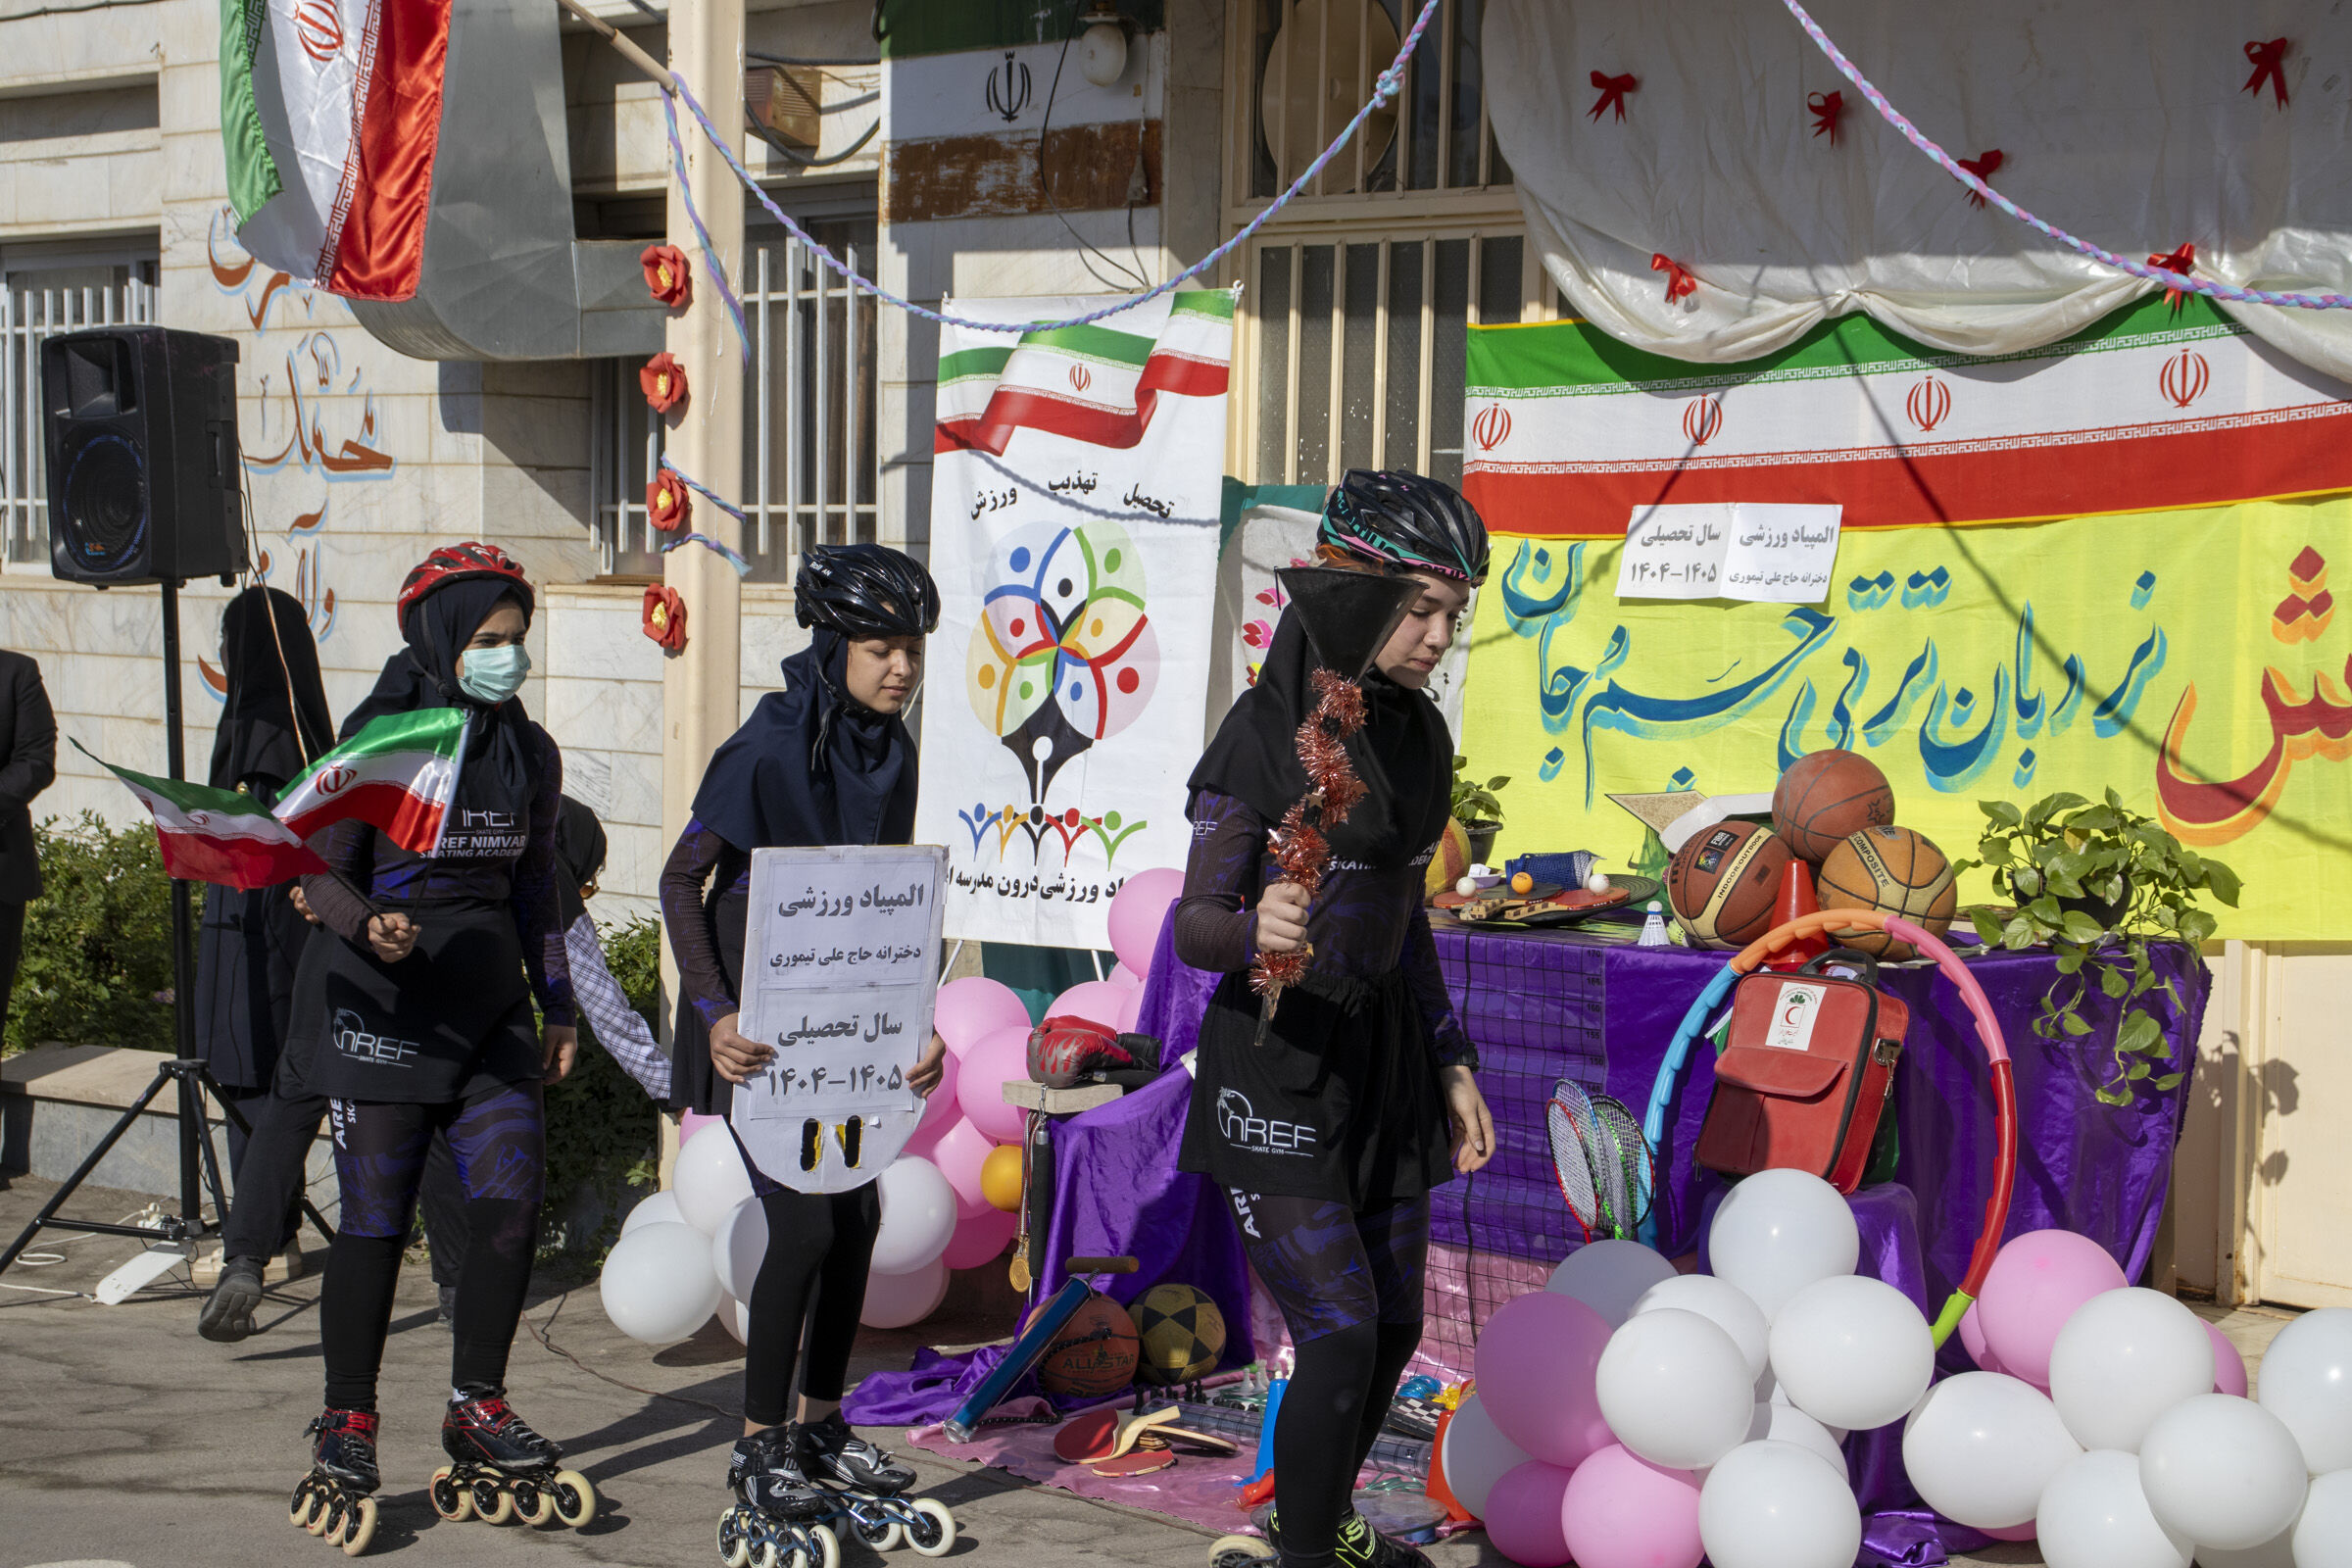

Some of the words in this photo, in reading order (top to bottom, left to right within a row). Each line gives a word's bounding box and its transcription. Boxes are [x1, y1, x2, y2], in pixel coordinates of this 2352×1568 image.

[1048, 469, 1099, 497] تهذیب
[970, 486, 1017, 520] ورزش
[1123, 482, 1175, 519] تحصیل
[1641, 524, 1694, 548] تحصیلی
[1695, 523, 1721, 547] سال
[1740, 523, 1788, 549] ورزشی
[1791, 524, 1835, 550] المپیاد
[1729, 570, 1764, 583] تیموری
[1765, 571, 1782, 585] علی
[1783, 573, 1798, 585] حاج
[1800, 571, 1828, 587] دخترانه
[439, 836, 468, 851] REF
[1717, 834, 1763, 900] INDOOR/OUTDOOR
[1852, 834, 1890, 888] COMPOSITE
[956, 870, 994, 895] مدرسه
[997, 873, 1039, 899] درون
[1040, 872, 1100, 904] ورزشی
[778, 885, 854, 917] ورزشی
[858, 882, 925, 916] المپیاد
[769, 948, 816, 968] تیموری
[817, 947, 844, 966] علی
[847, 946, 872, 965] حاج
[875, 943, 921, 964] دخترانه
[1587, 950, 1601, 958] 170
[777, 1013, 859, 1047] تحصیلی
[863, 1011, 903, 1044] سال
[1586, 1031, 1600, 1040] 155
[1589, 1057, 1604, 1067] 150
